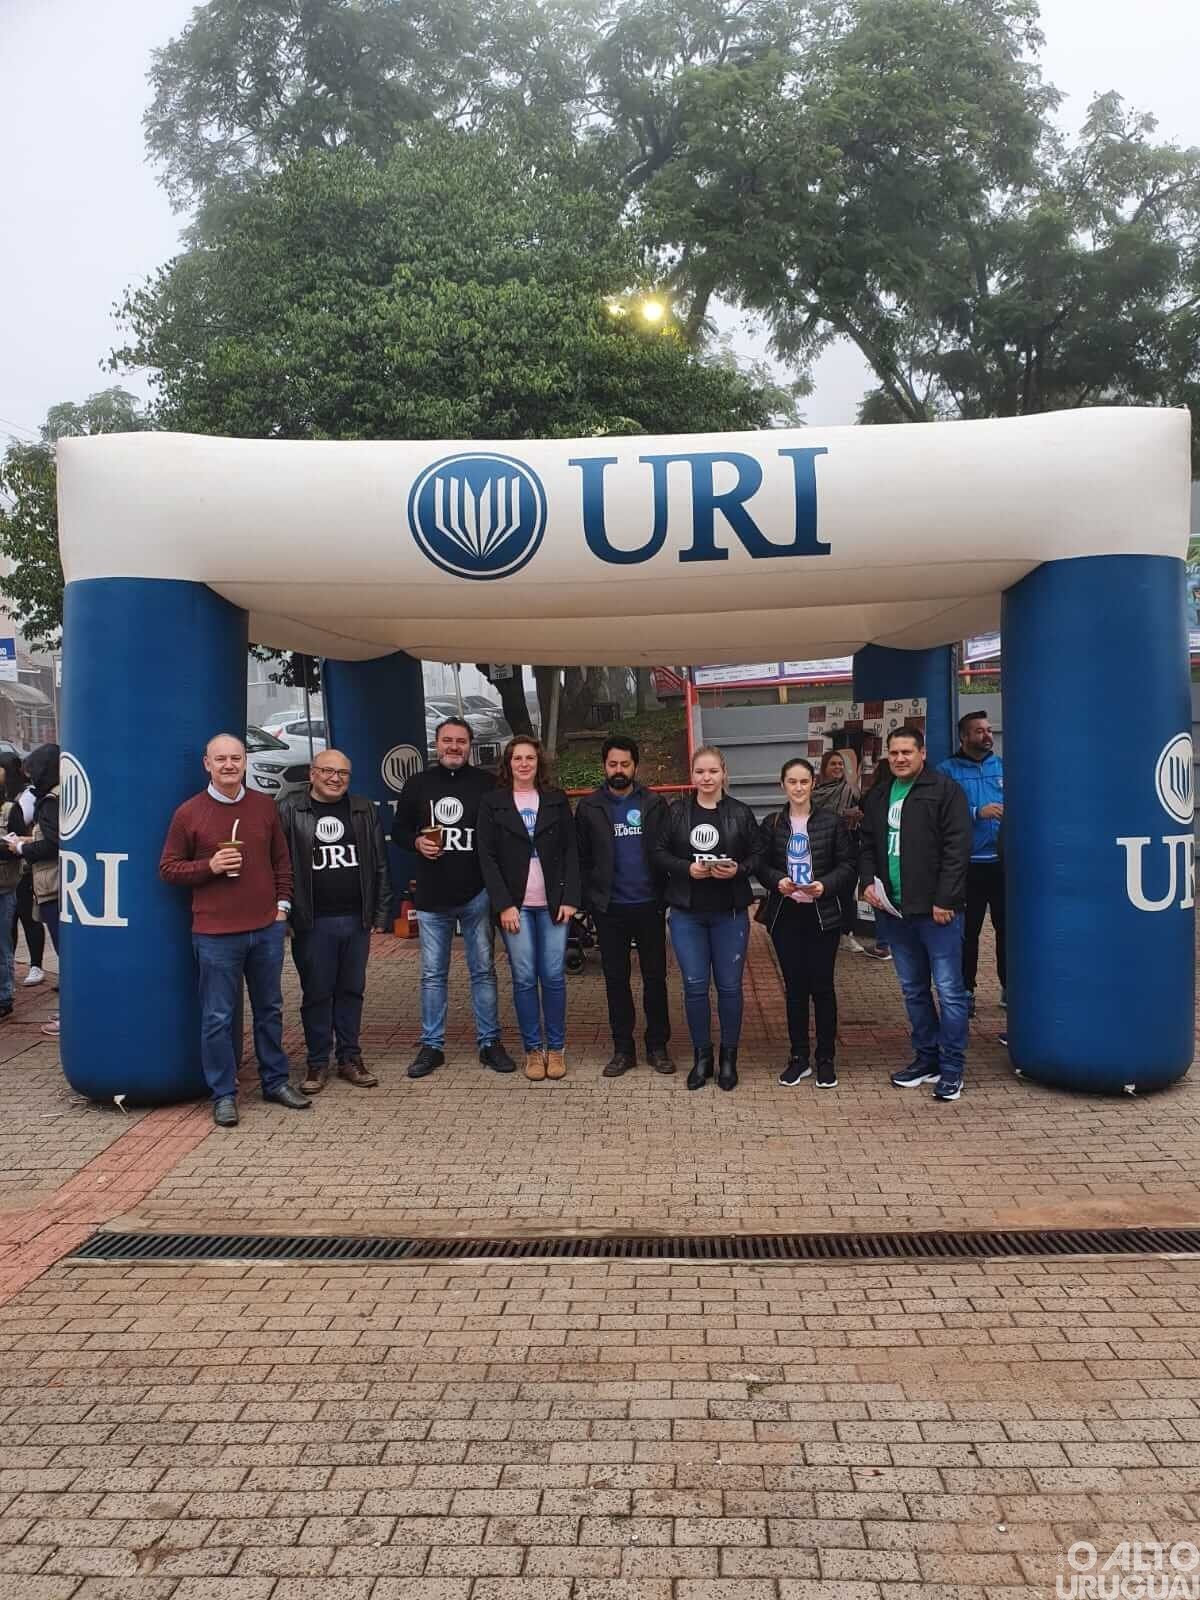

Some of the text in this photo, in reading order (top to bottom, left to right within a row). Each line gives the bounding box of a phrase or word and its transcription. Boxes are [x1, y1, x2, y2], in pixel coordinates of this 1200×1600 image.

[568, 446, 832, 565] URI
[58, 850, 129, 927] RI
[312, 844, 359, 870] URI
